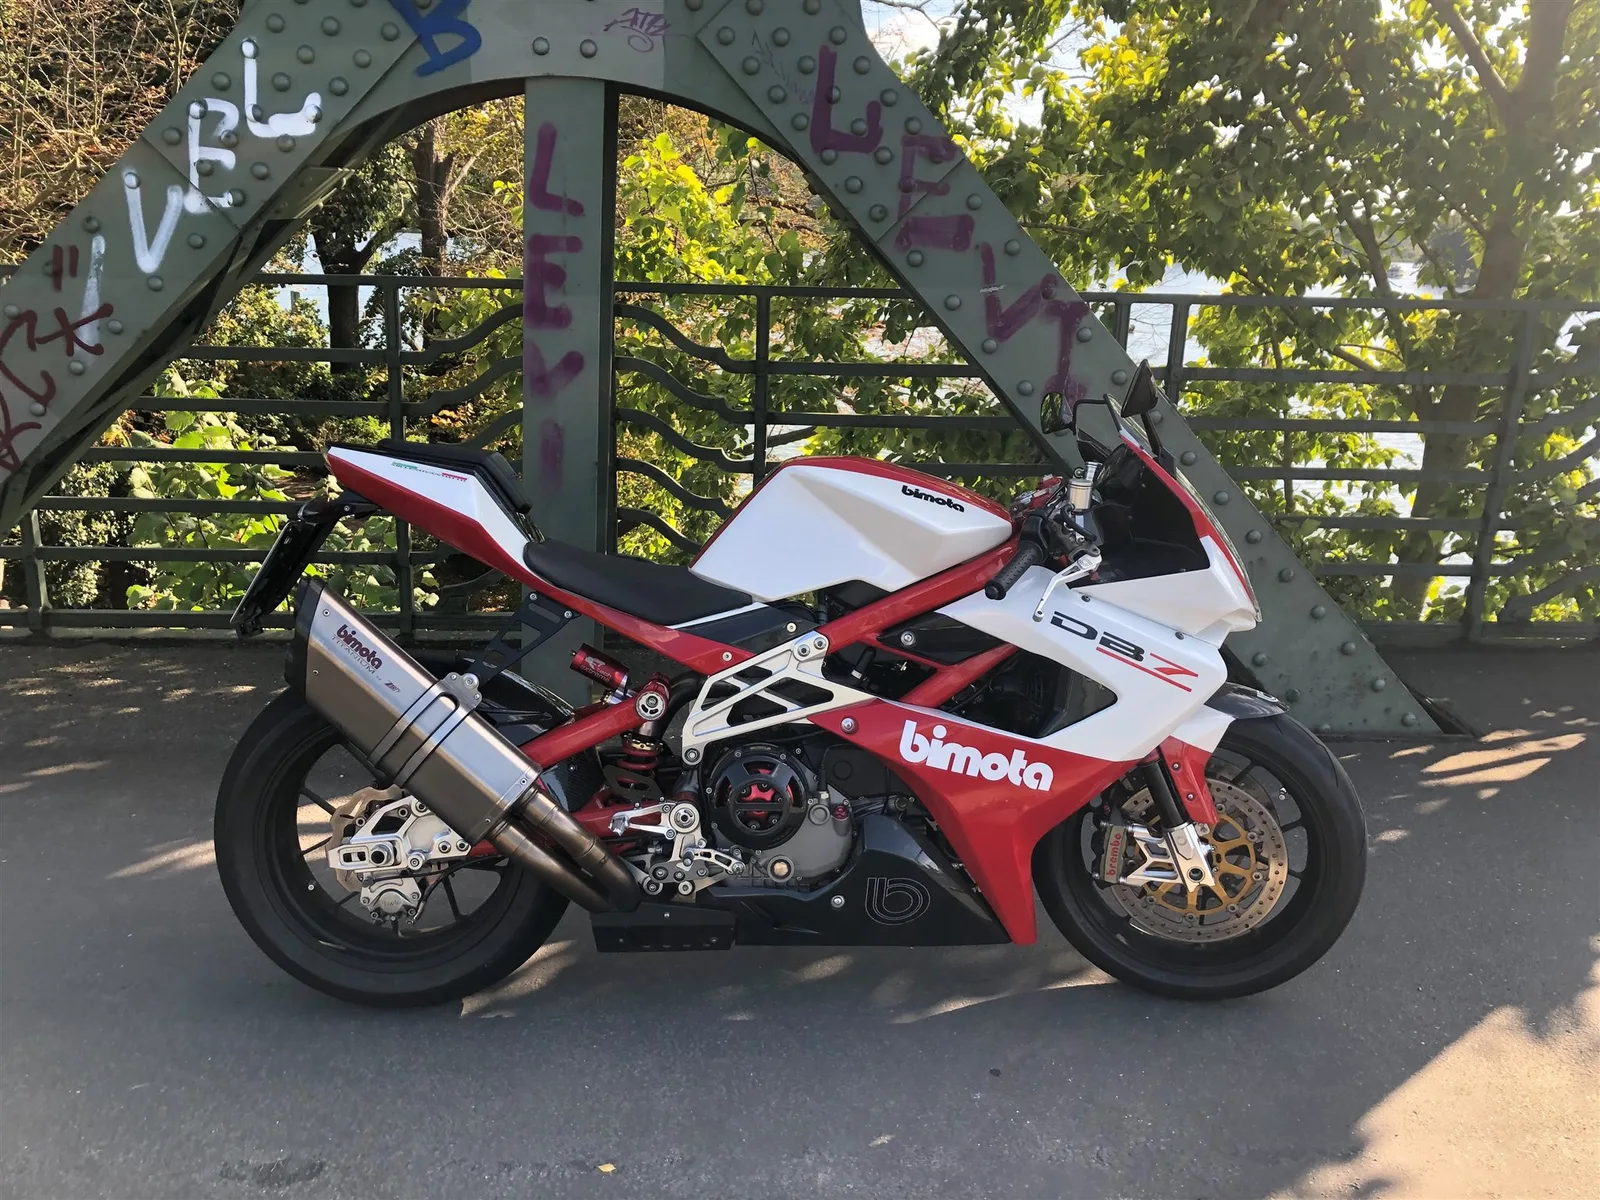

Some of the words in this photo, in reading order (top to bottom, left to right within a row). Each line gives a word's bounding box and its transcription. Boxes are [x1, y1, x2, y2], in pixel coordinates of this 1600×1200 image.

[901, 484, 965, 513] bimota
[331, 634, 377, 675] TITANIUM
[336, 623, 383, 670] bimota
[1049, 610, 1199, 682] DB7
[899, 719, 1054, 792] bimota
[1105, 832, 1122, 877] brembo
